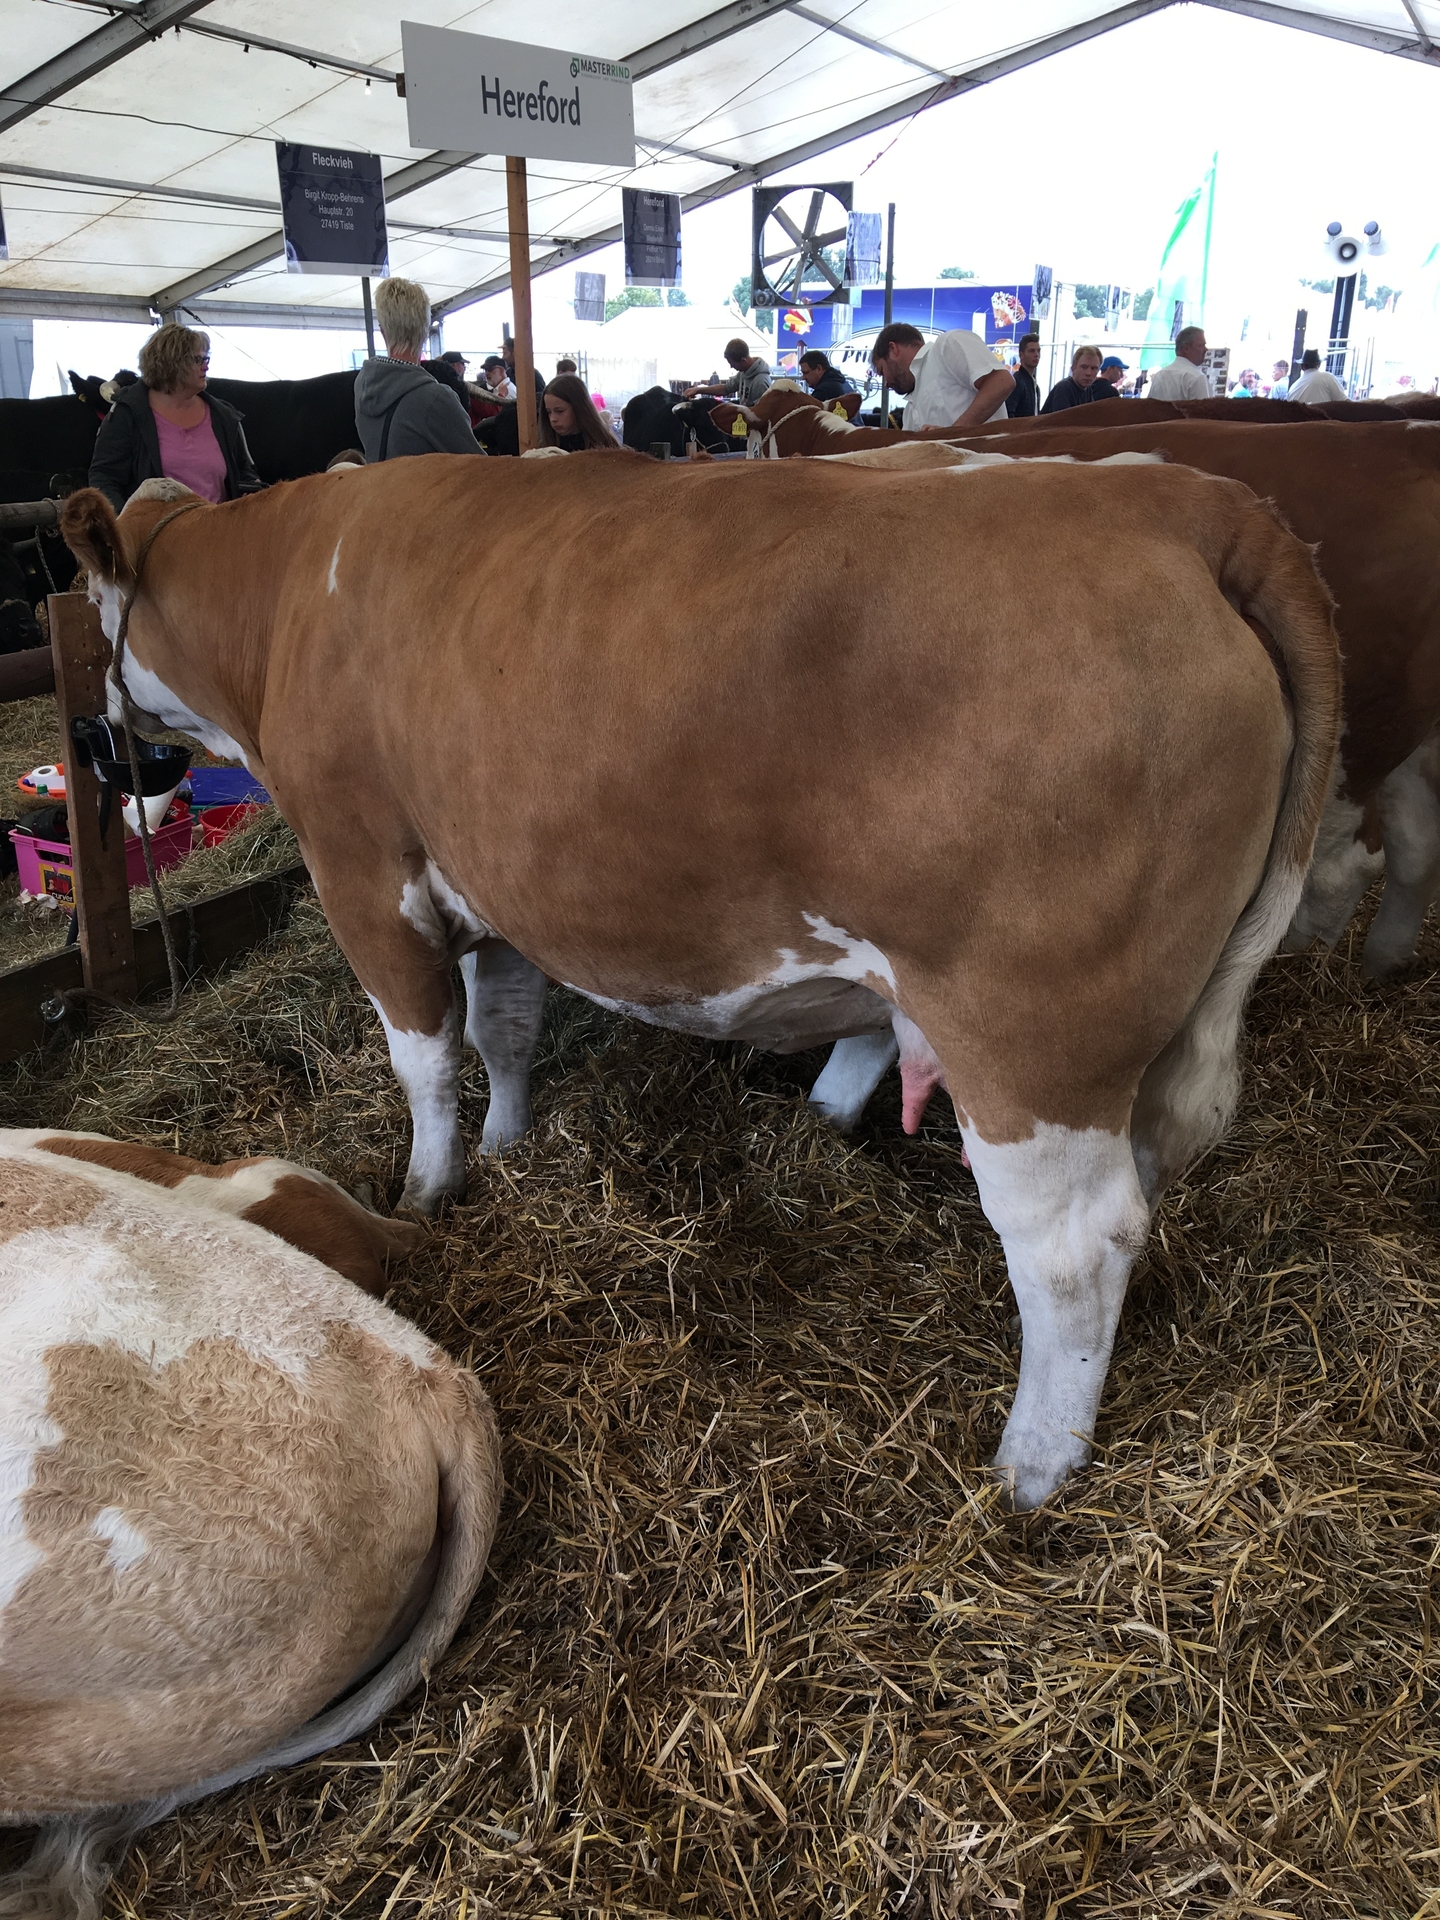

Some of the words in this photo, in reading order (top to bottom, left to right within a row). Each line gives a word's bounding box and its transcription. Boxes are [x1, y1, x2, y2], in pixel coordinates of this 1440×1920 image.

[581, 59, 630, 79] MASTERRIND
[481, 75, 581, 126] Hereford
[312, 152, 353, 169] Fleckvieh
[304, 188, 320, 201] Birgit
[643, 195, 665, 208] Hereford
[318, 204, 345, 216] Hauptstr.
[345, 206, 354, 217] 20
[320, 218, 339, 229] 27419
